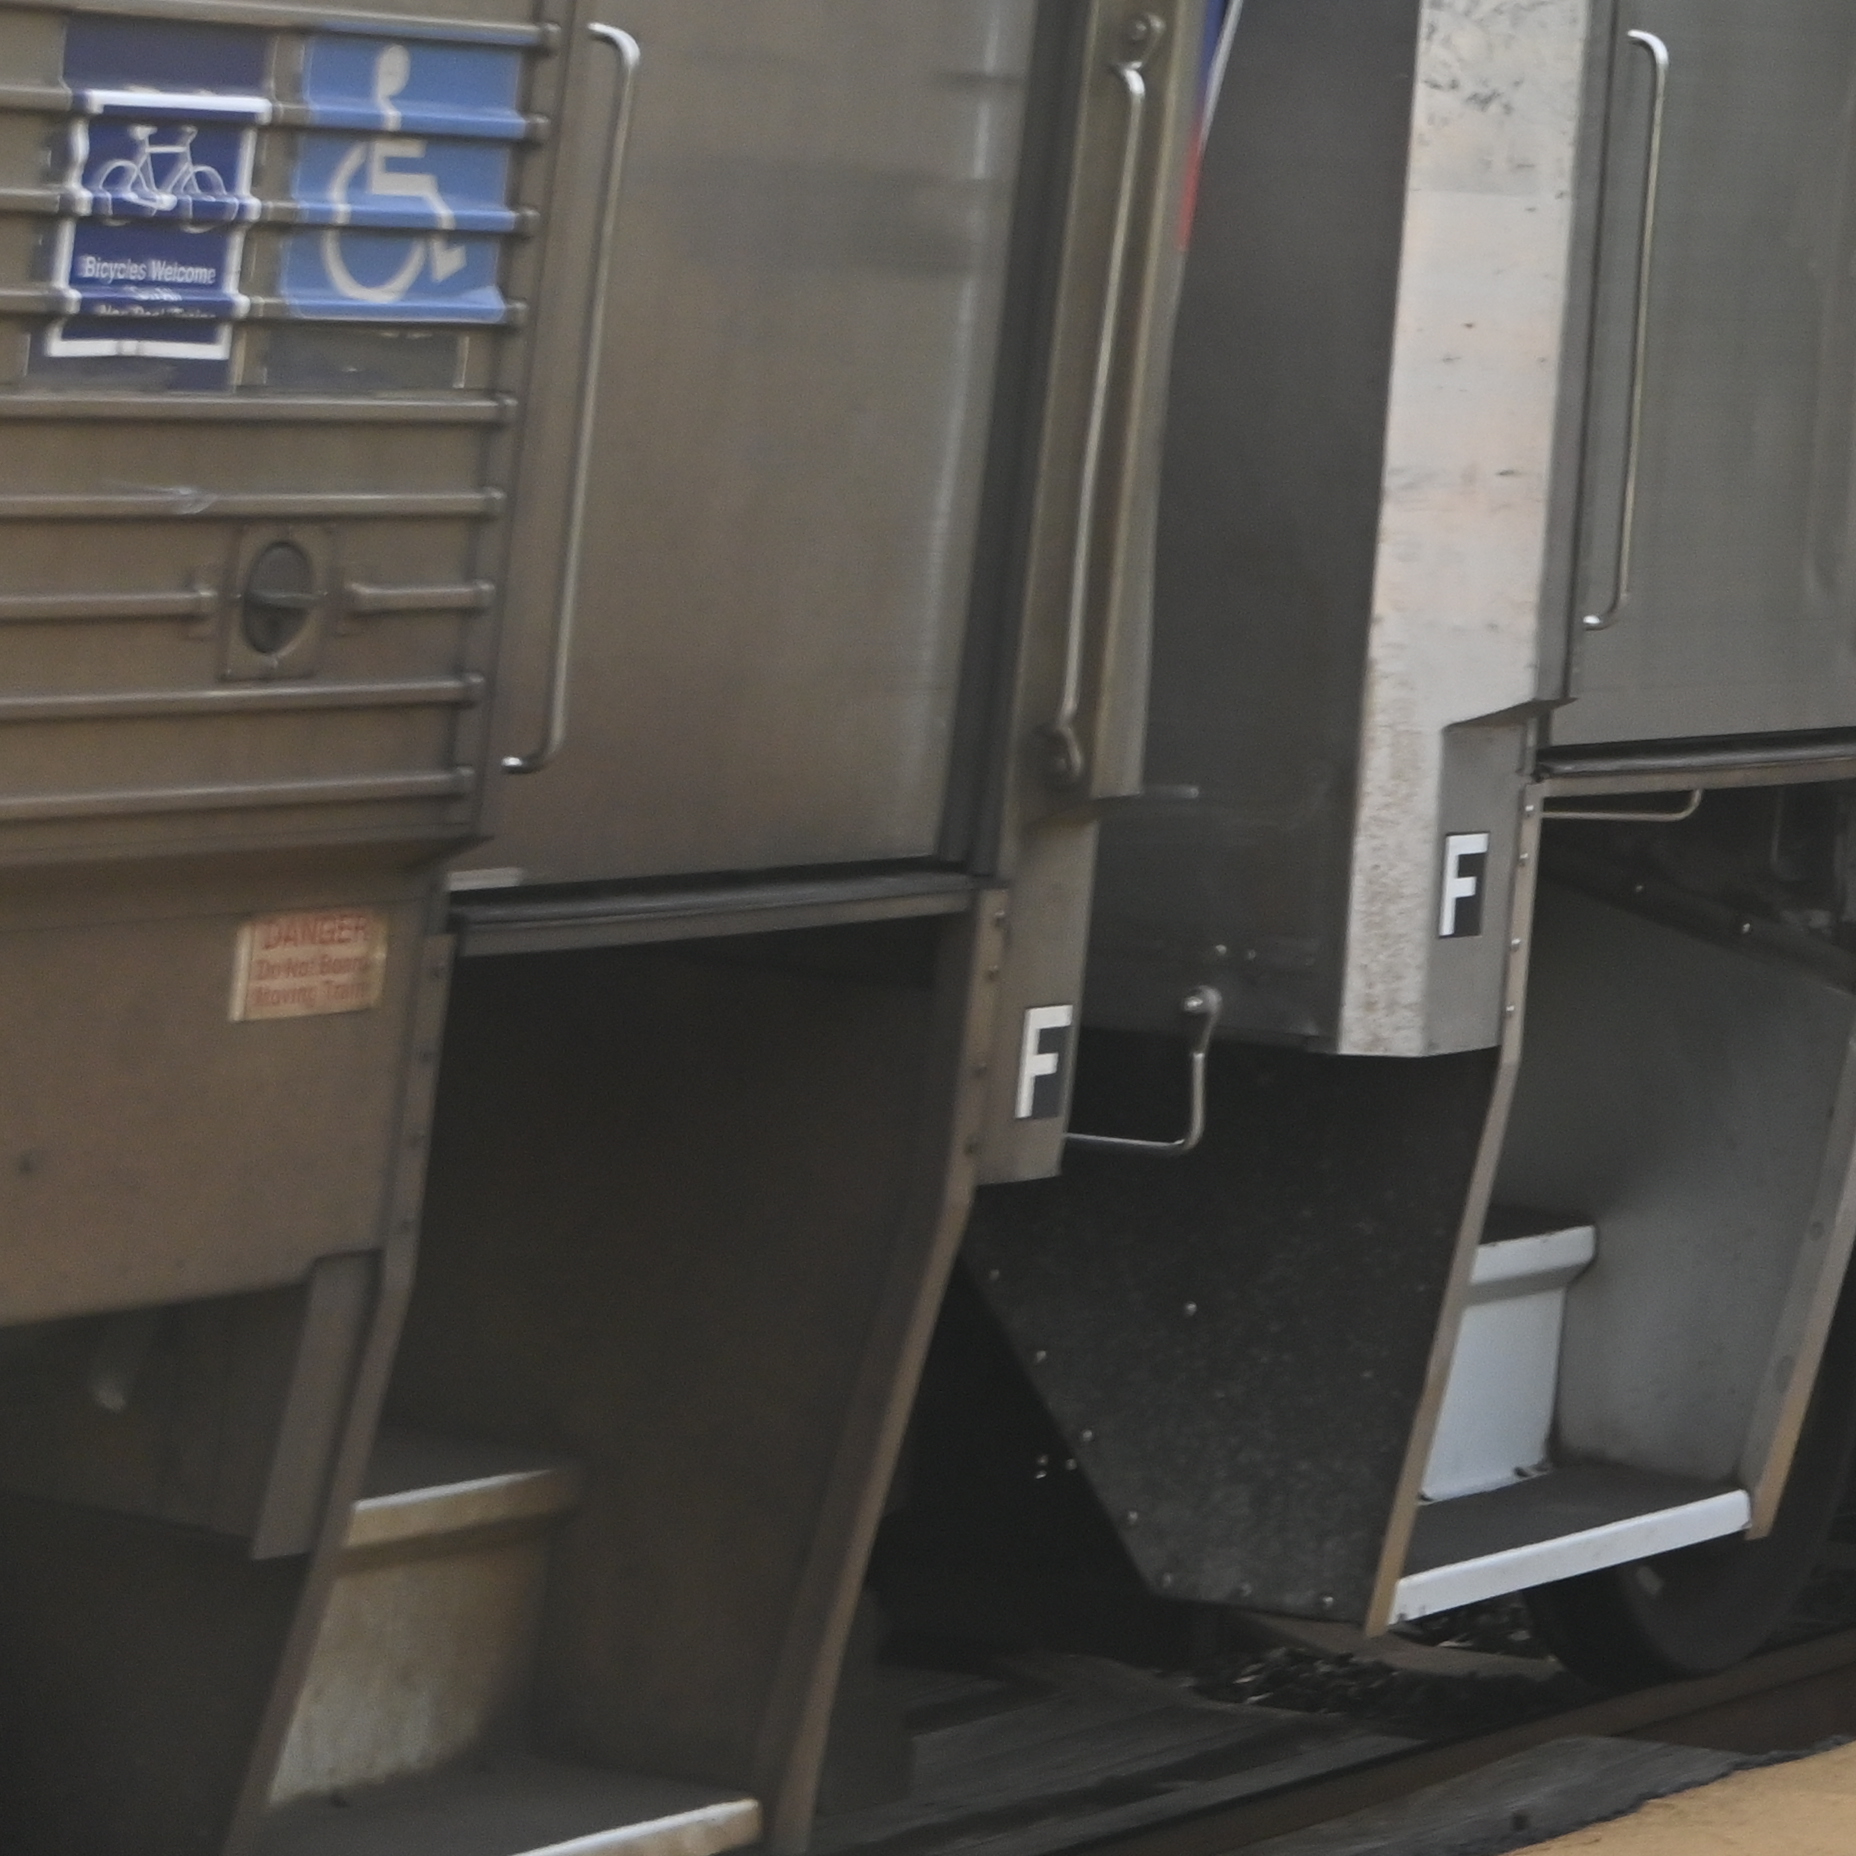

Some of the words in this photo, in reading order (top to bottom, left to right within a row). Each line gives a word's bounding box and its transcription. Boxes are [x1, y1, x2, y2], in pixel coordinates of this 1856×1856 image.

[81, 255, 147, 284] Bicycles
[150, 259, 216, 285] Welcome
[1438, 833, 1490, 938] F
[257, 912, 370, 950] DANGER
[1014, 1005, 1073, 1119] F
